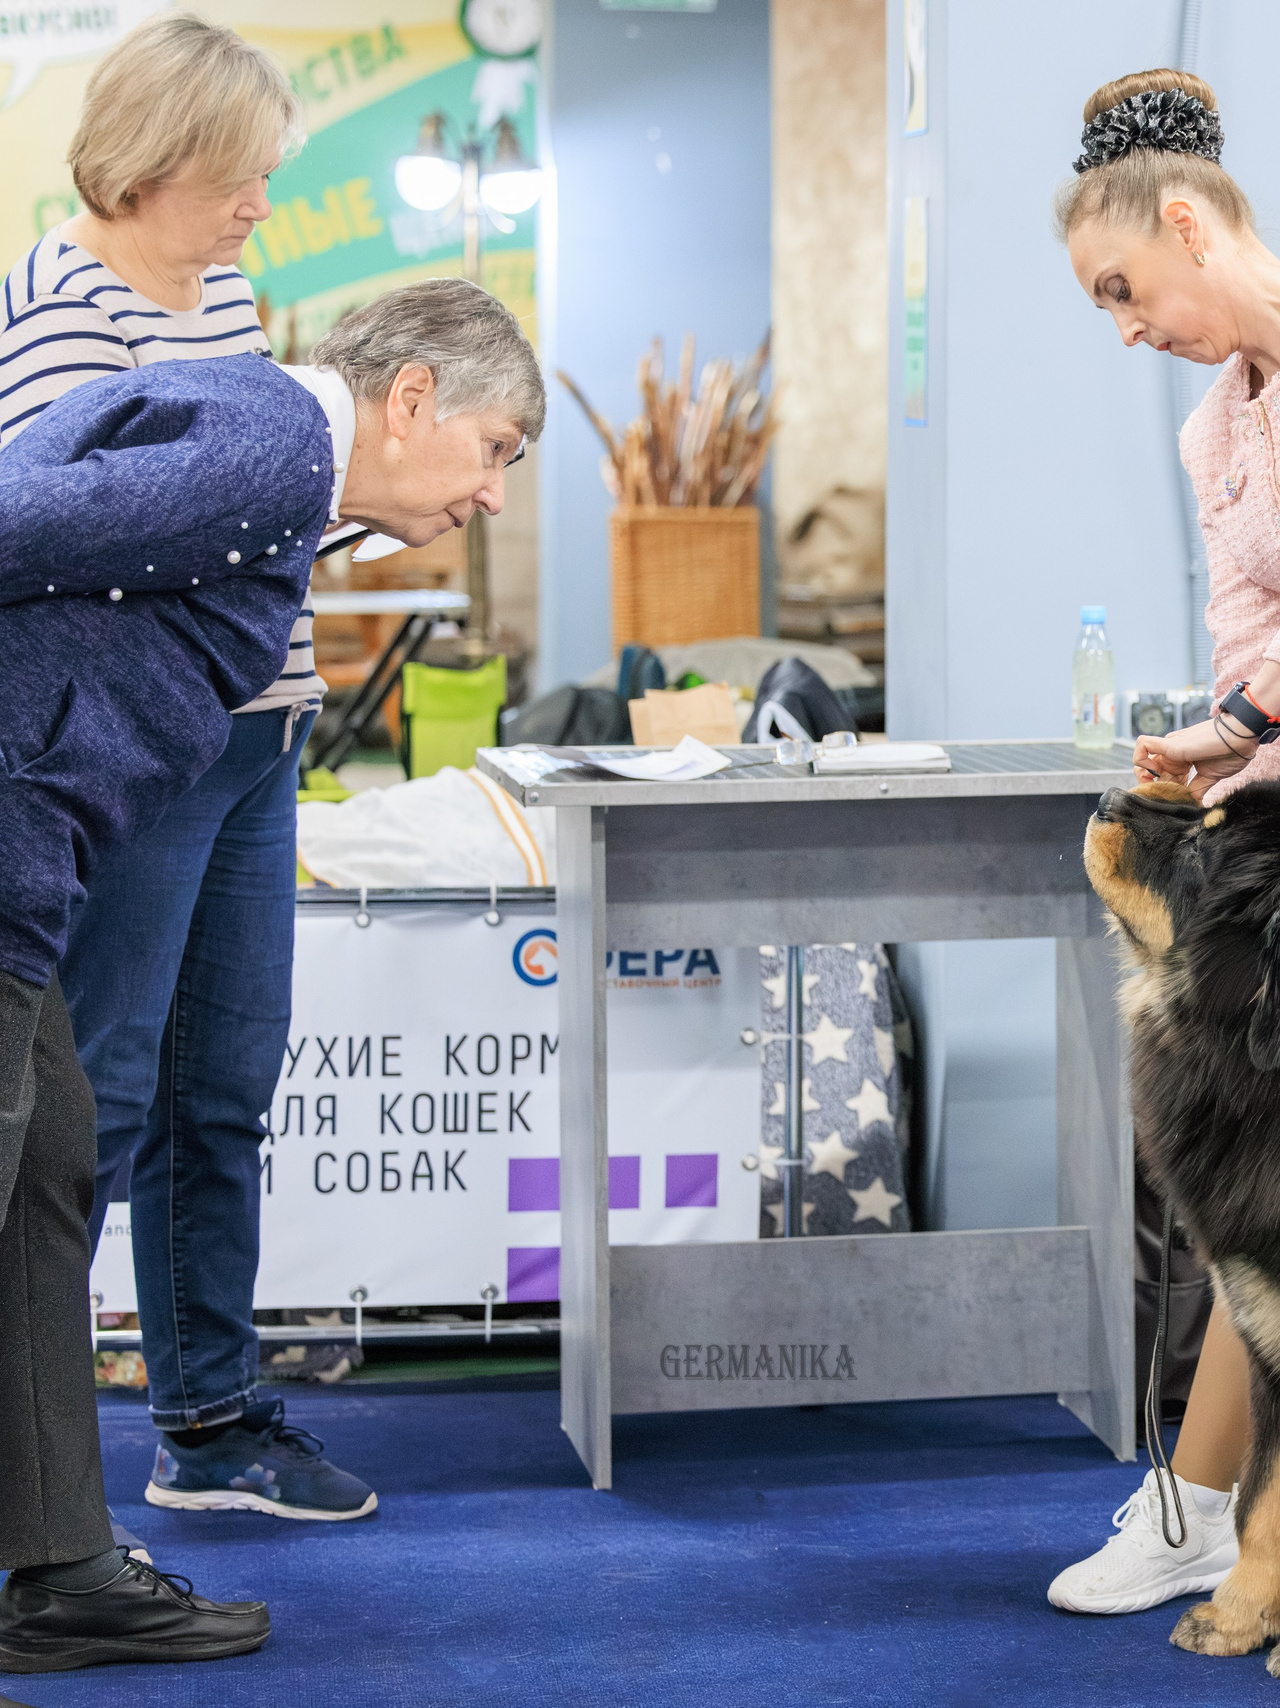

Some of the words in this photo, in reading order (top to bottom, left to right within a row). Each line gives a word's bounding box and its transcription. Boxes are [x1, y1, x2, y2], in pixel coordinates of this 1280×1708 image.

[380, 1091, 532, 1135] КОШЕК
[314, 1150, 468, 1194] СОБАК
[659, 1344, 858, 1383] GERMANIKA
